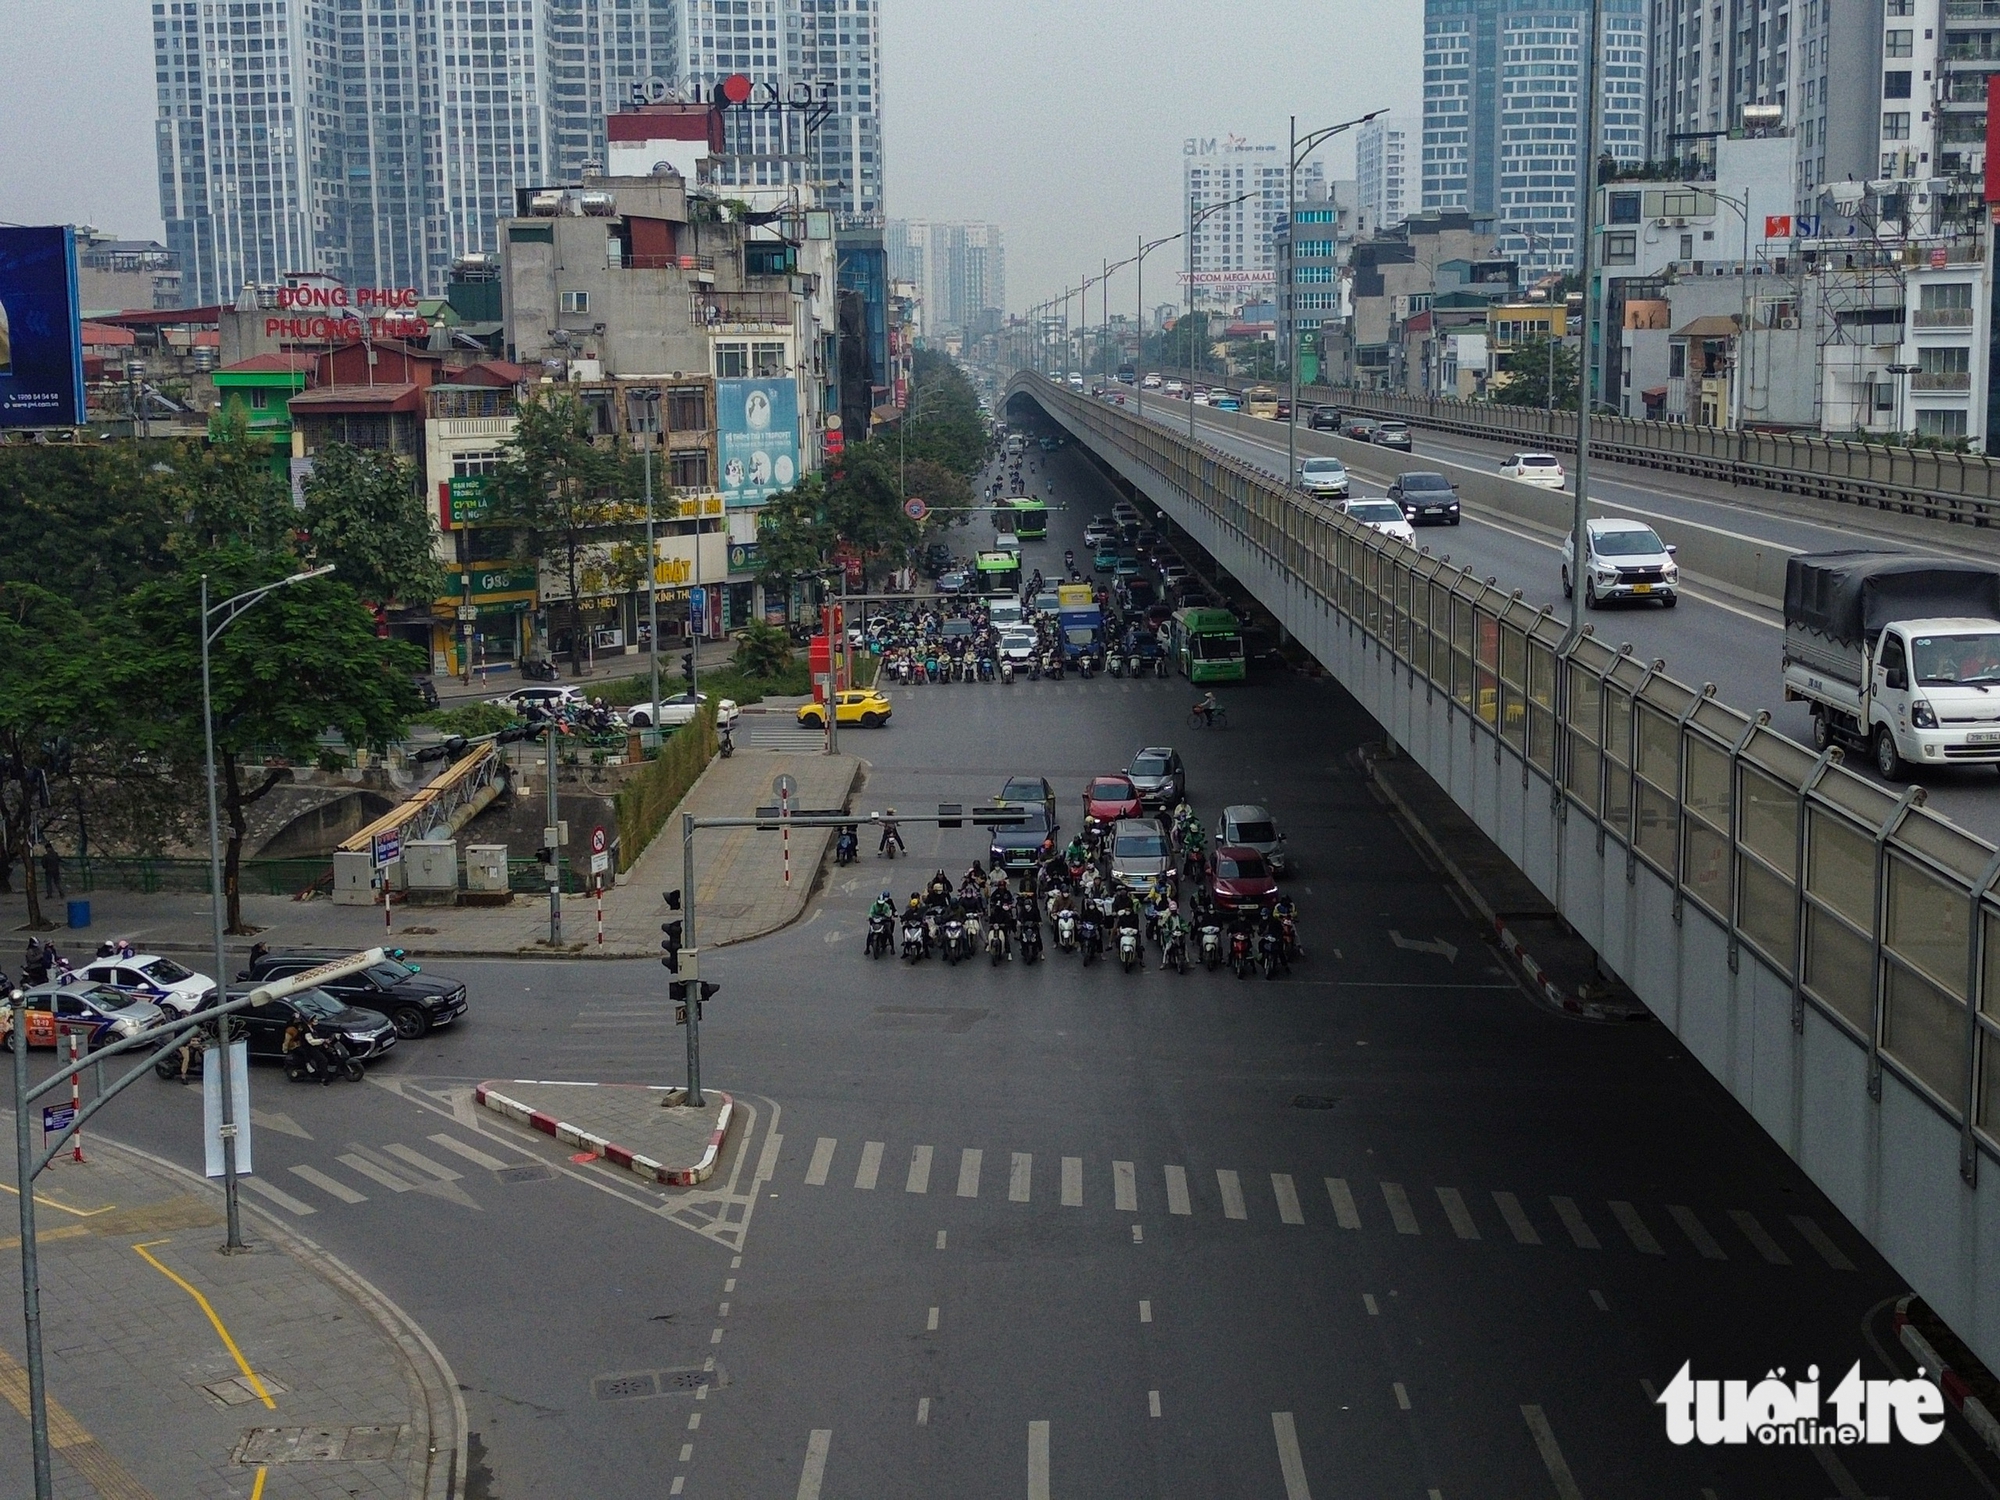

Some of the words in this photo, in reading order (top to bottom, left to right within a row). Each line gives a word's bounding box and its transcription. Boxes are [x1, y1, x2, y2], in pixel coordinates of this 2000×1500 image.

[1223, 273, 1250, 281] MEGA
[1252, 272, 1276, 281] MALL
[482, 574, 509, 590] F88
